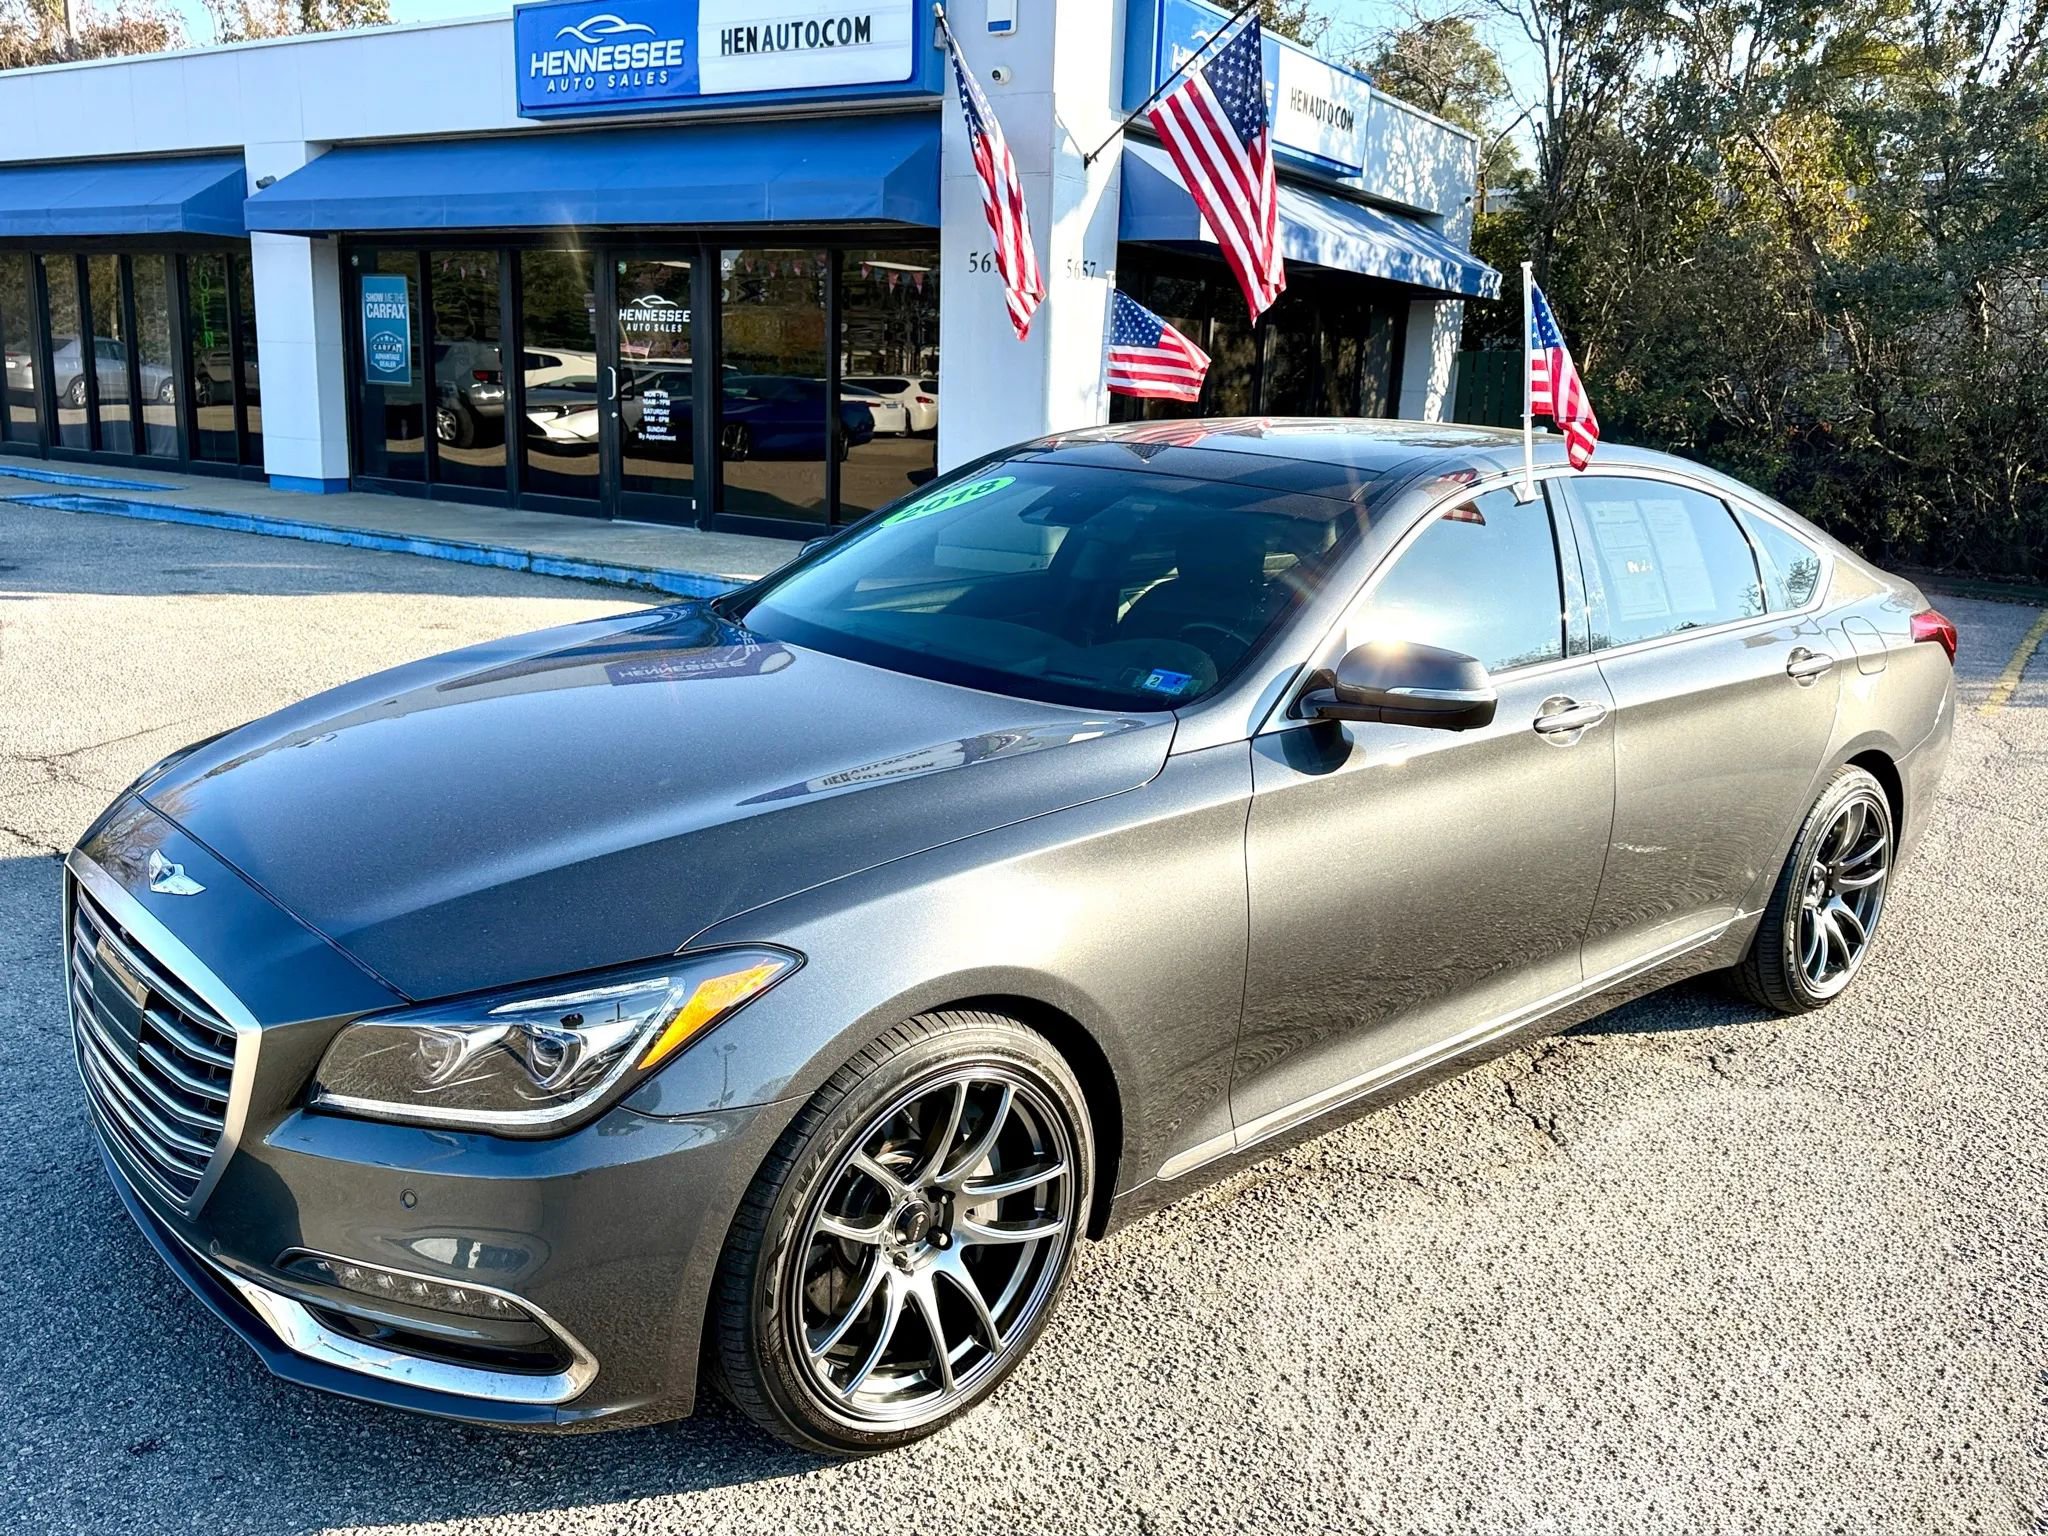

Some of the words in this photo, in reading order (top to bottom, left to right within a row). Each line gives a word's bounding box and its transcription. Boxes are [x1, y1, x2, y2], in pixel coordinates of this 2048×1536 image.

[721, 15, 872, 56] HENAUTO.COM
[531, 39, 684, 77] HENNESSEE
[547, 77, 595, 93] AUTO
[608, 70, 668, 88] SALES
[1066, 258, 1097, 280] 5657
[365, 292, 383, 303] SHOW
[366, 302, 406, 319] CARFAX
[619, 308, 691, 322] HENNESSEE
[626, 322, 650, 332] AUTO
[654, 323, 682, 333] SALES
[643, 407, 670, 415] SATURDAY
[638, 432, 645, 440] By
[646, 425, 667, 433] SUNDAY
[893, 479, 1001, 523] 2018
